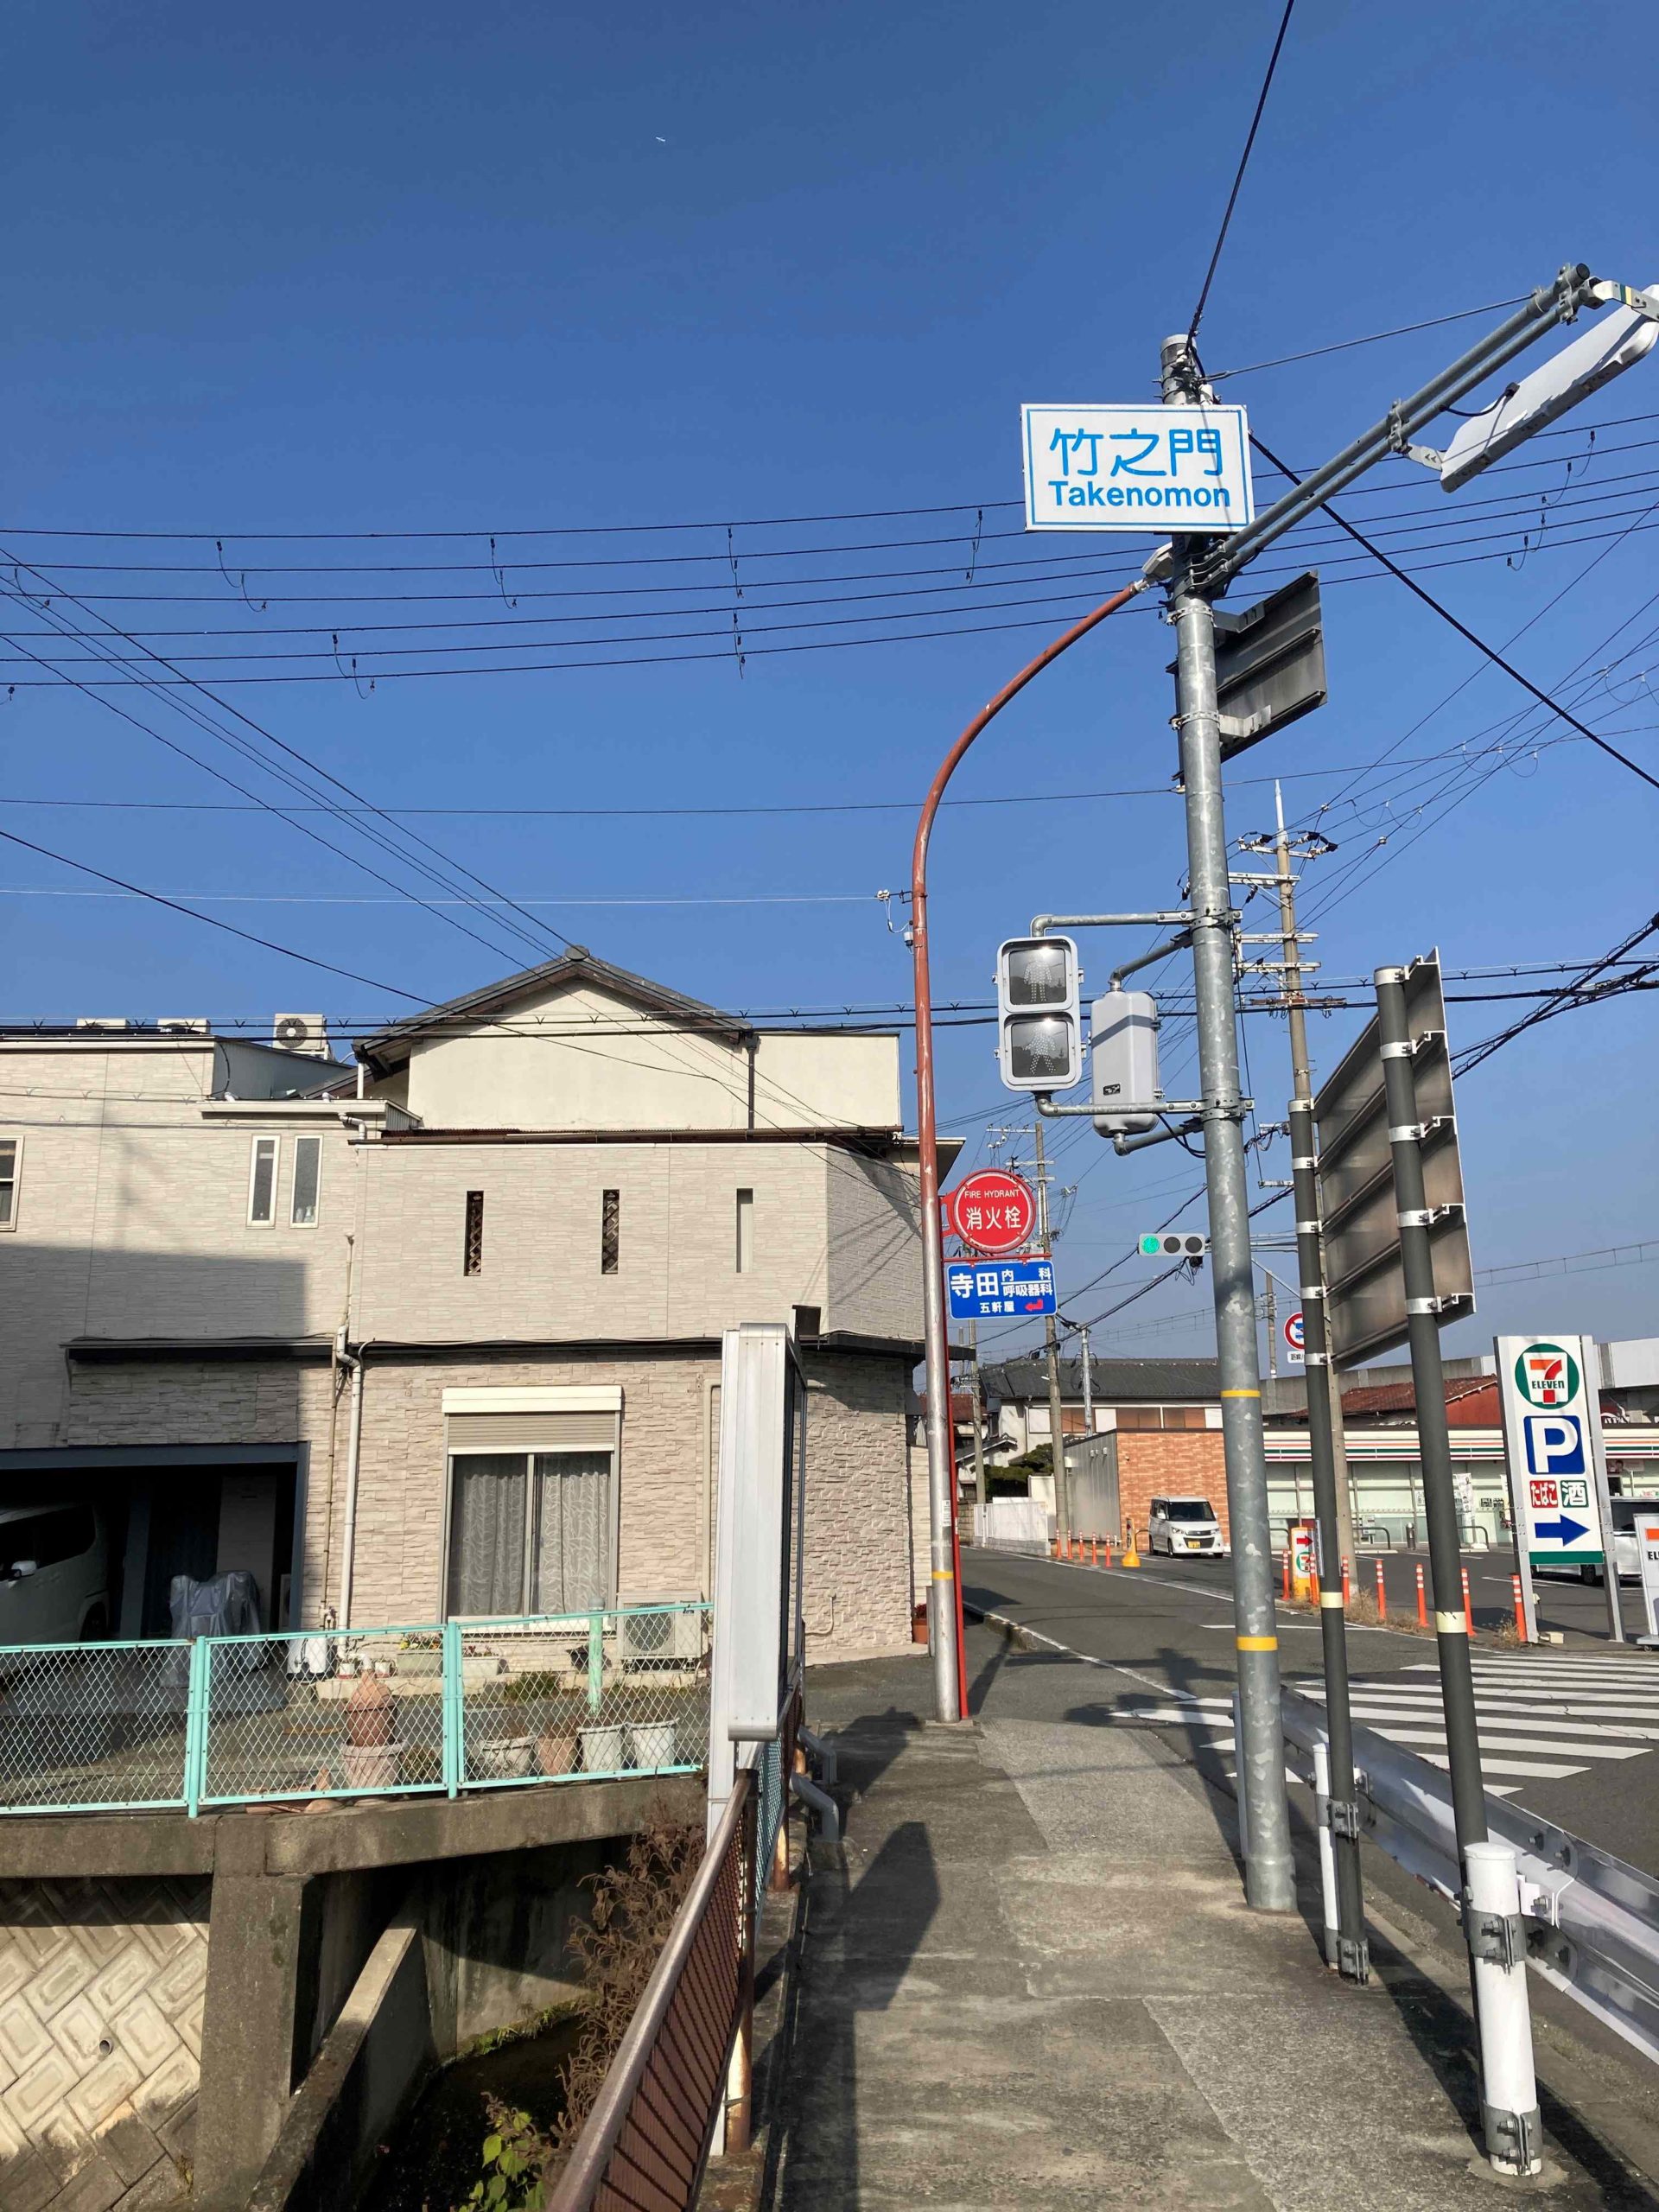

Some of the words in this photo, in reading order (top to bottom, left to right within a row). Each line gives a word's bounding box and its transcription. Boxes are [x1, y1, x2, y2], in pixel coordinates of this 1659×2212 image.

[1049, 428, 1223, 476] 竹之門
[1048, 480, 1230, 507] Takenomon
[984, 1189, 1020, 1198] HYDRANT
[966, 1205, 1021, 1230] 消火栓
[950, 1272, 1000, 1298] 寺田
[1002, 1282, 1053, 1298] 呼吸器科
[1530, 1418, 1579, 1473] P
[1530, 1482, 1558, 1506] たばこ
[1561, 1481, 1587, 1506] 酒
